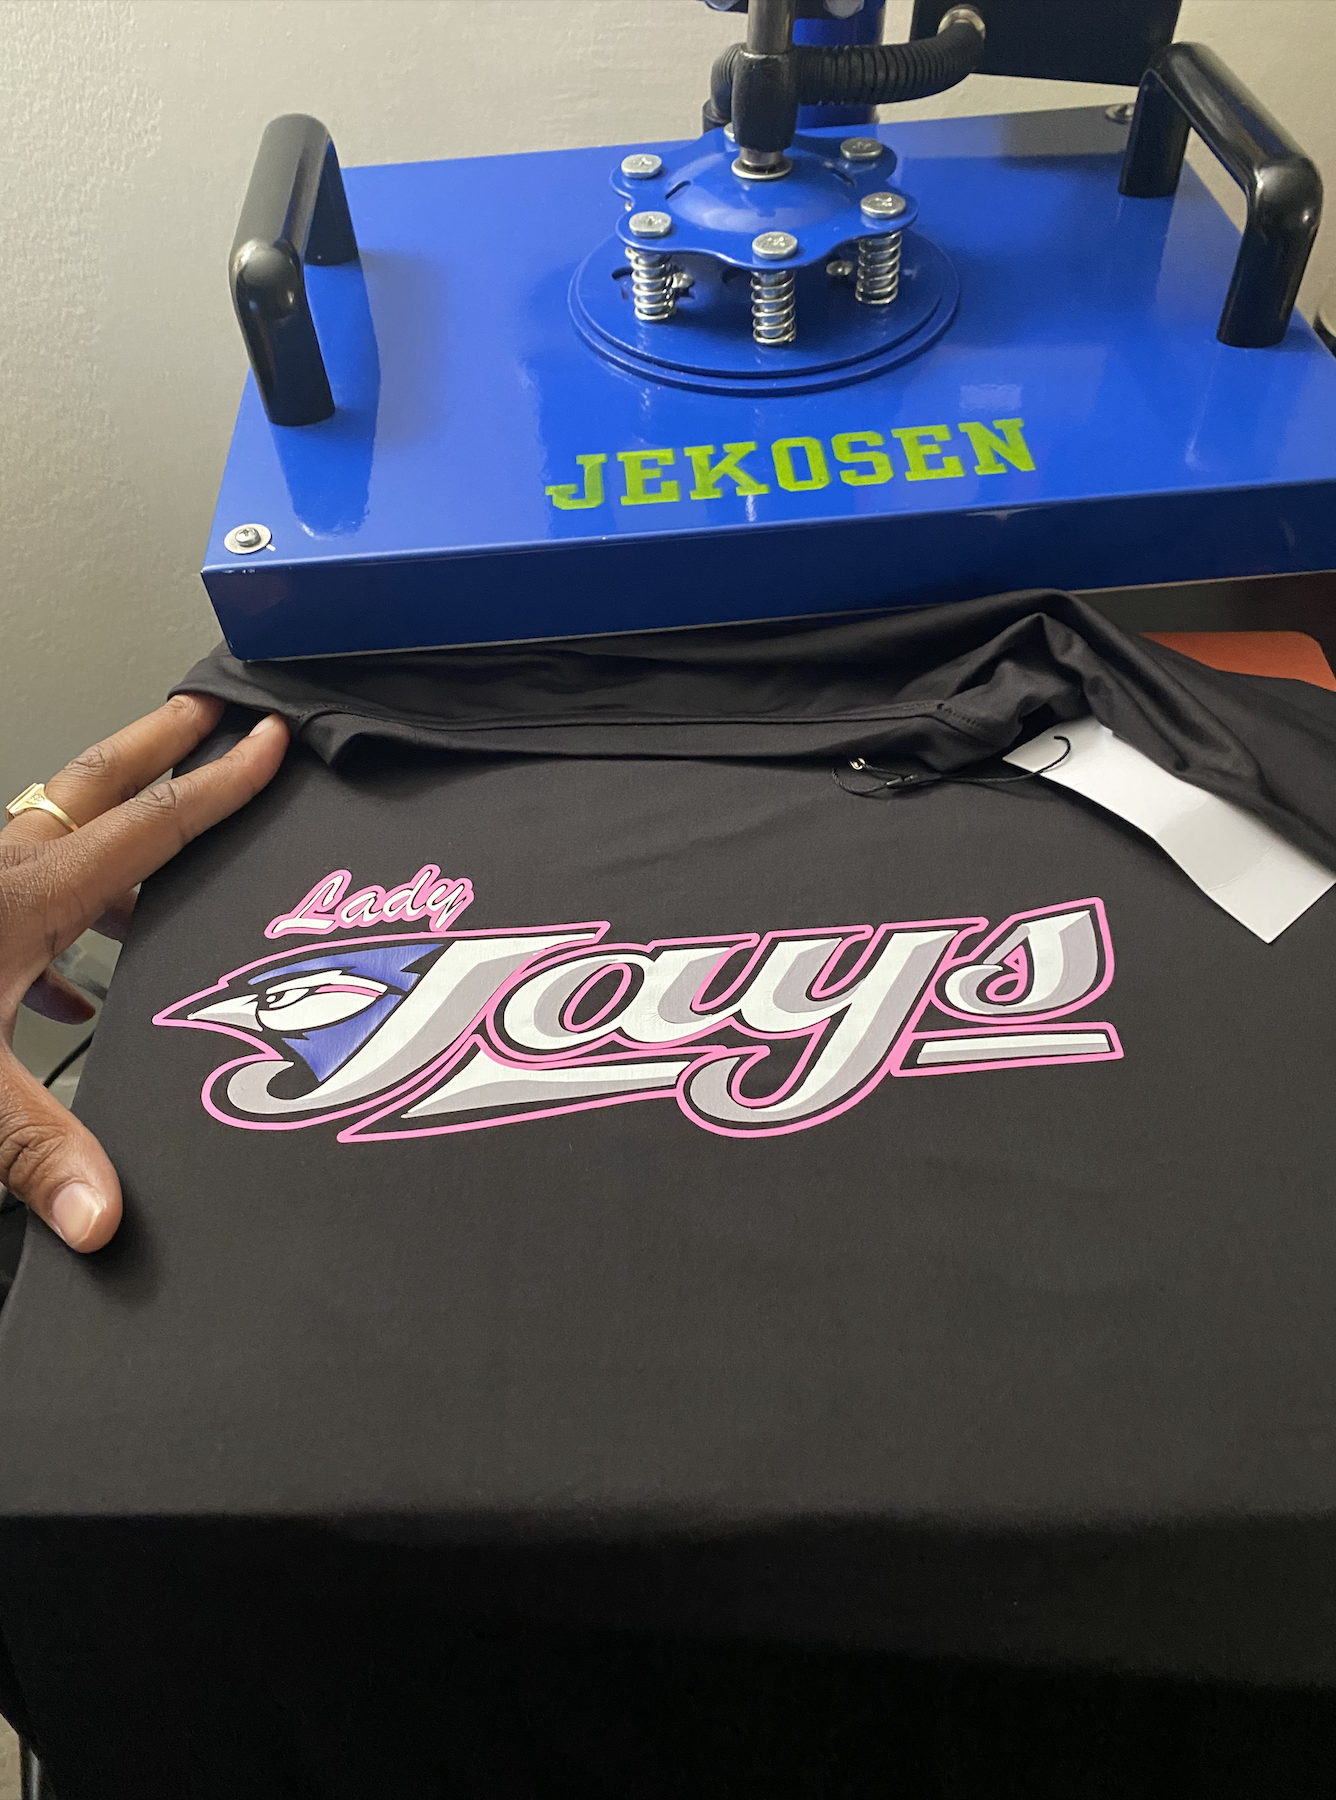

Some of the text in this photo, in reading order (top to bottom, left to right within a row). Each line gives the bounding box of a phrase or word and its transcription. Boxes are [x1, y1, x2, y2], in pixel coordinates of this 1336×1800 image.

[545, 417, 1037, 511] JEKOSEN
[266, 864, 474, 939] Lady
[203, 898, 1115, 1138] Jays
